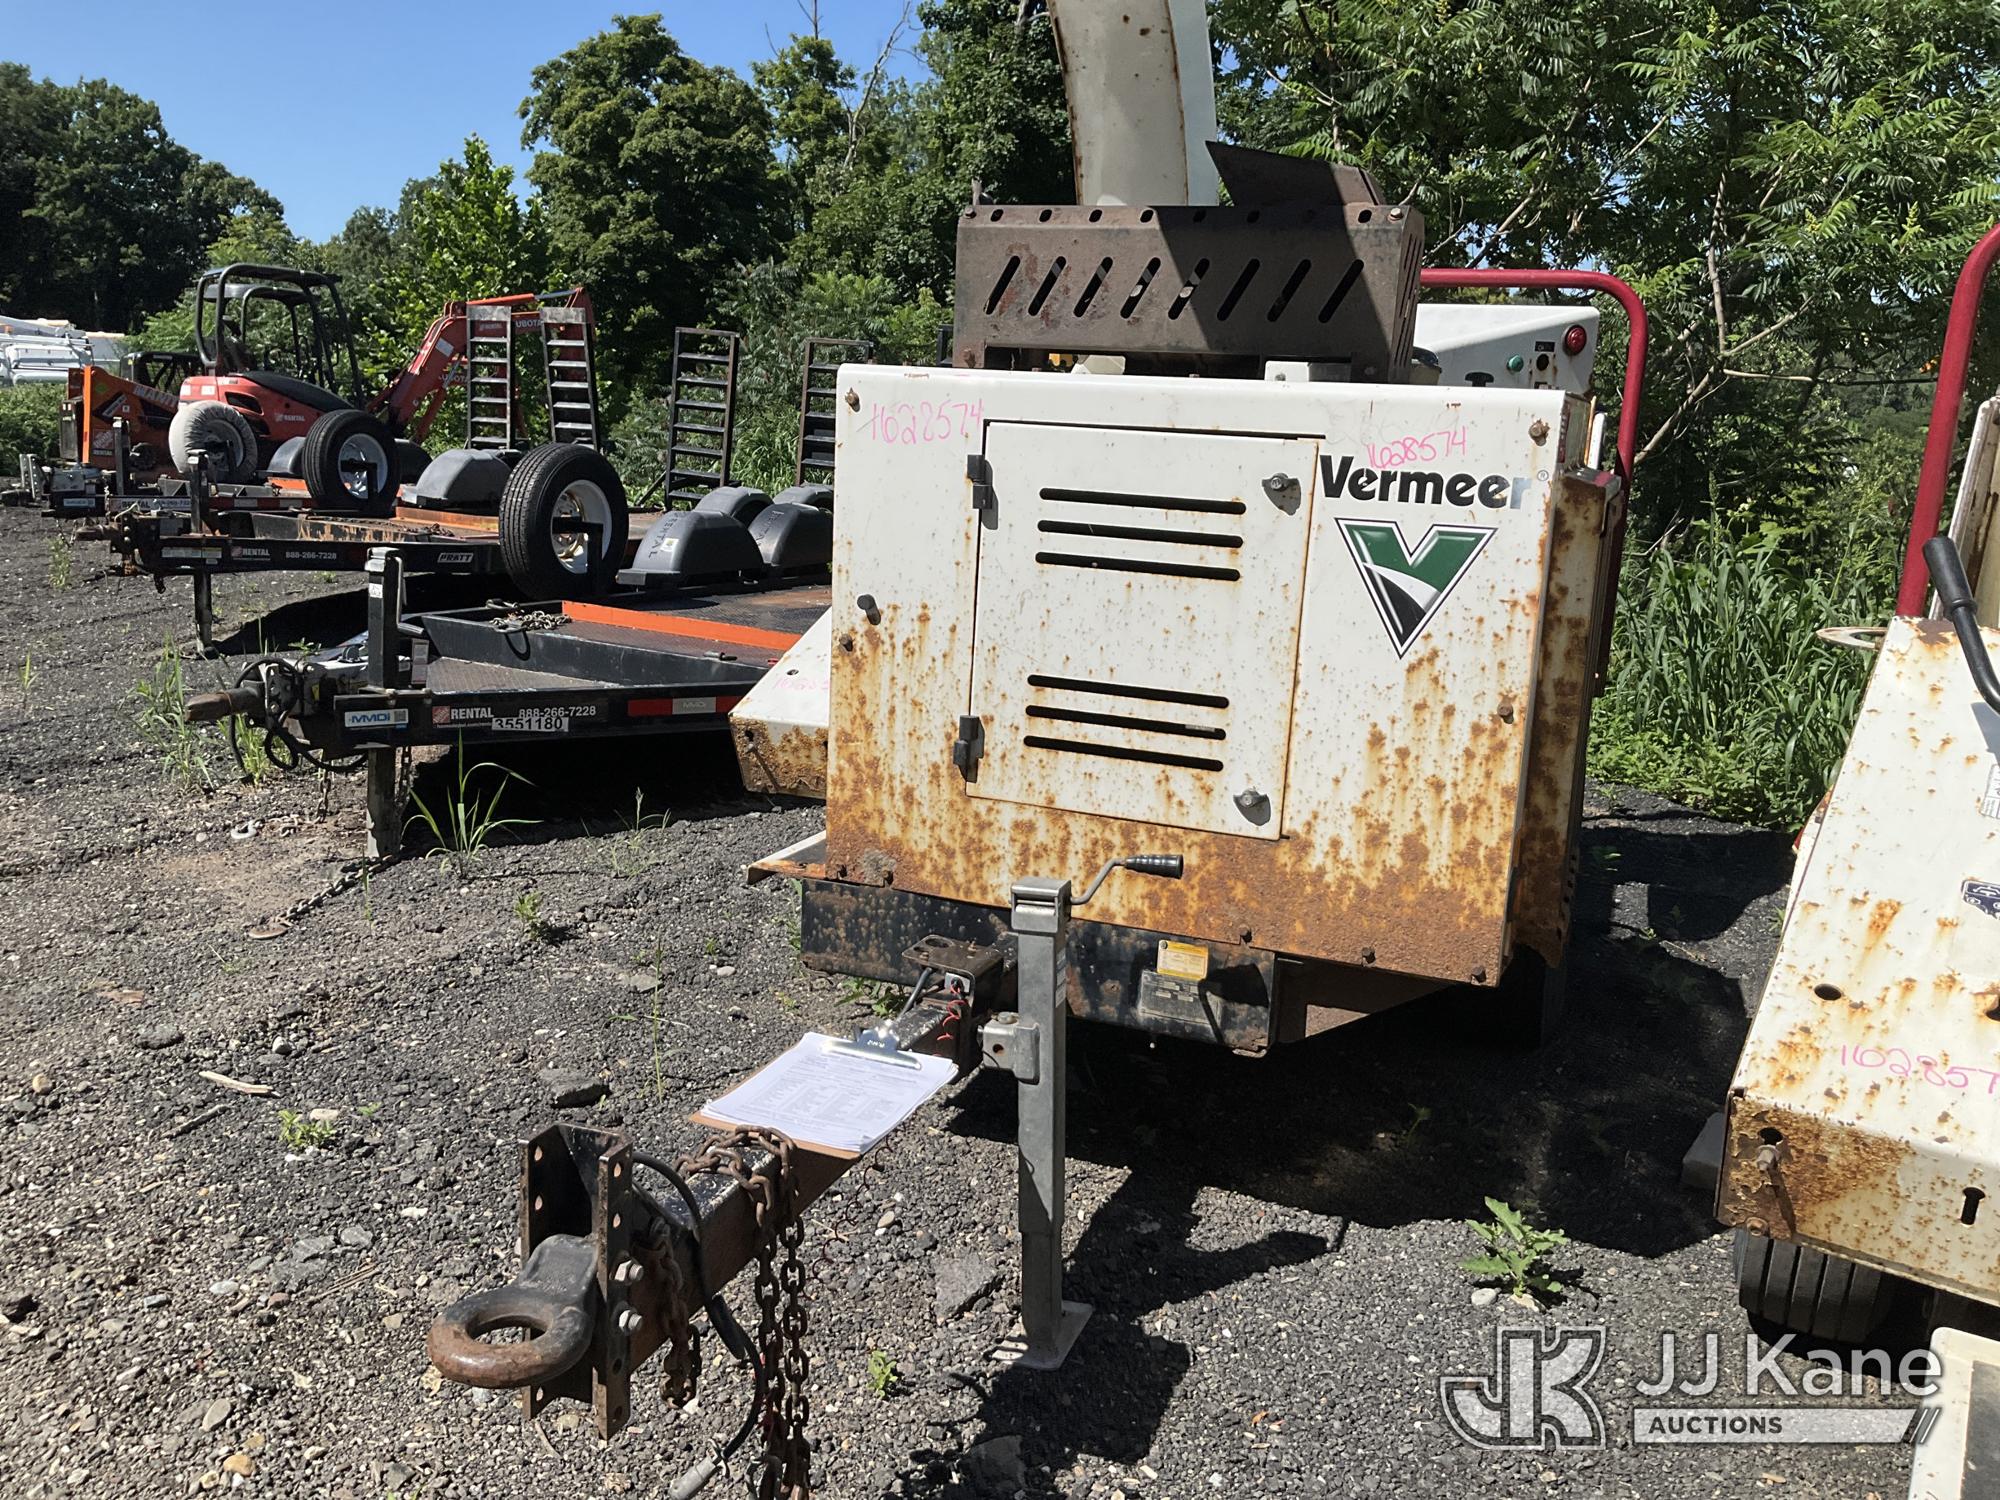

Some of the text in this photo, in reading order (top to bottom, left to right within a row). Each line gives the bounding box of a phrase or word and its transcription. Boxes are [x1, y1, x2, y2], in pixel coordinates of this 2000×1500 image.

[515, 319, 543, 328] UBOTA
[871, 398, 983, 445] 1628574
[1319, 455, 1533, 510] Vermeer
[451, 707, 494, 720] RENTAL
[519, 705, 596, 719] 888-266-7228
[494, 717, 563, 730] 3551180
